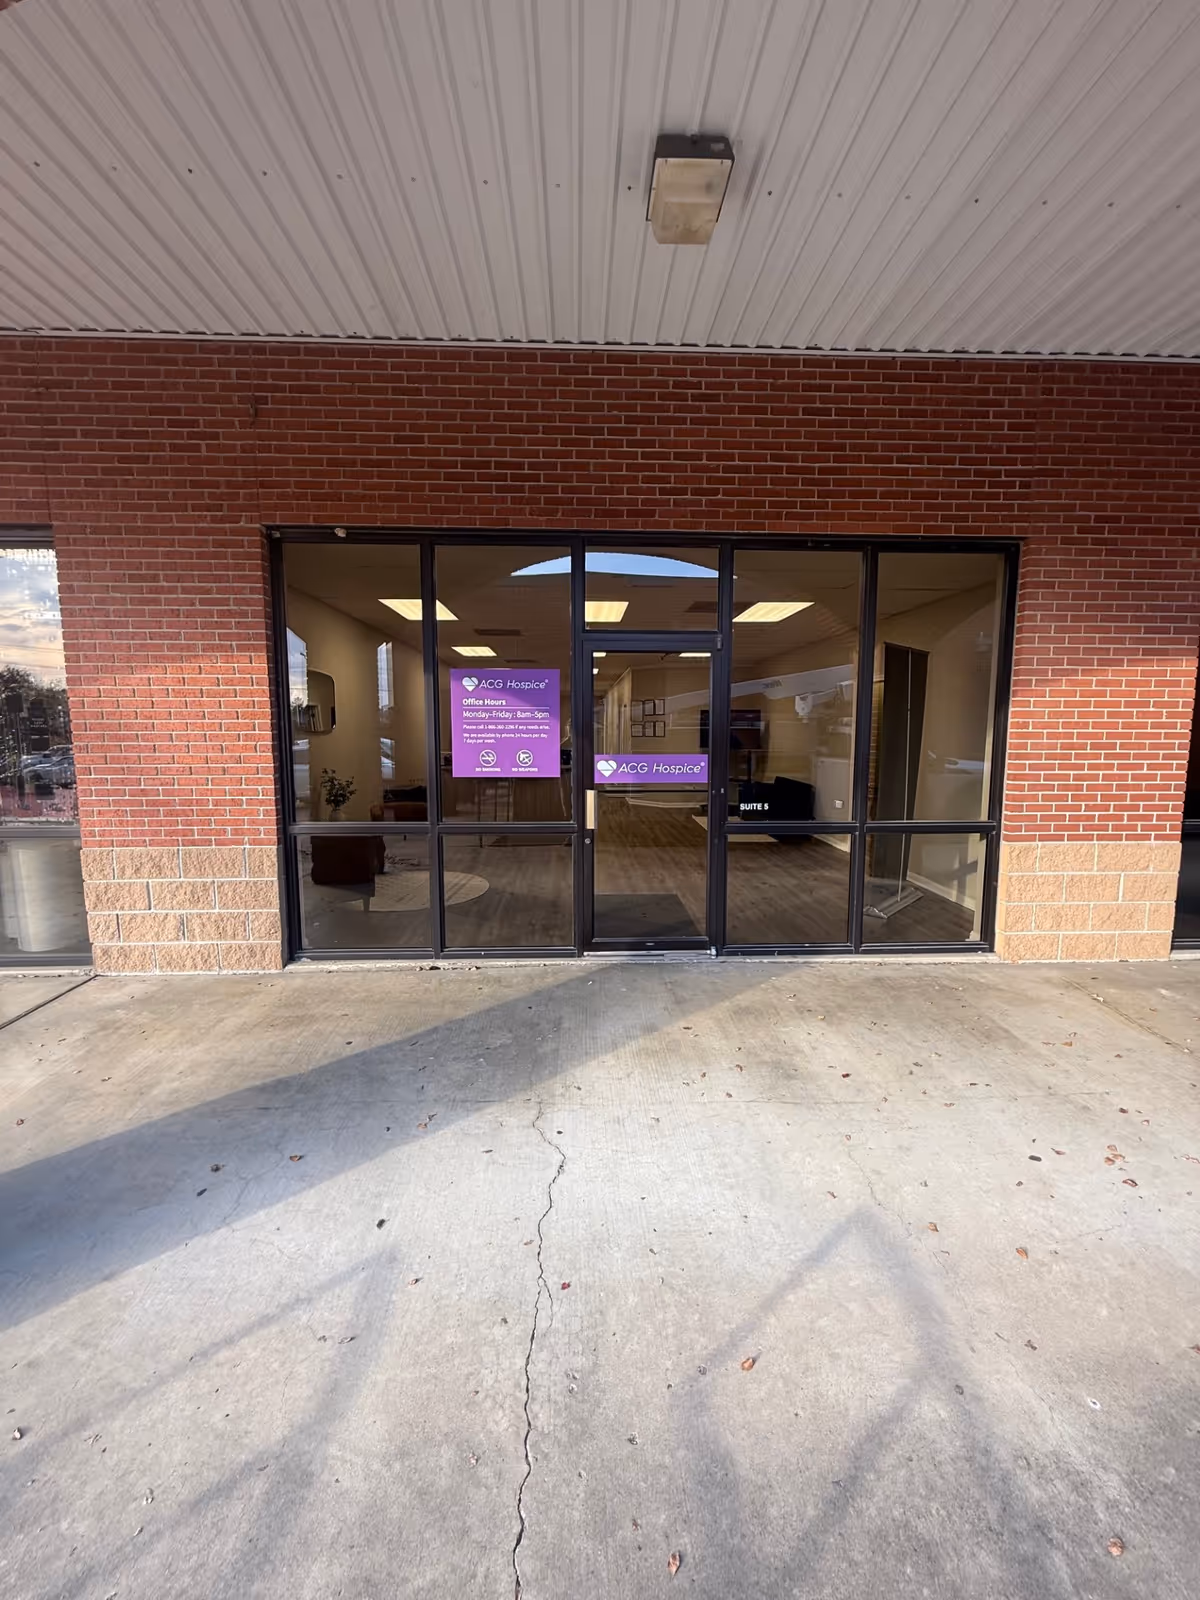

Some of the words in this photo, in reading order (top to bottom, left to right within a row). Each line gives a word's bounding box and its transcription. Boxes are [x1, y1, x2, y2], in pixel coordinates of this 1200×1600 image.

[479, 679, 503, 689] ACG
[507, 679, 546, 690] Hospice
[462, 698, 483, 706] Office
[484, 698, 506, 706] Hours
[618, 762, 648, 774] ACG
[652, 762, 701, 775] Hospice
[740, 802, 763, 811] SUITE
[763, 803, 769, 811] 5
